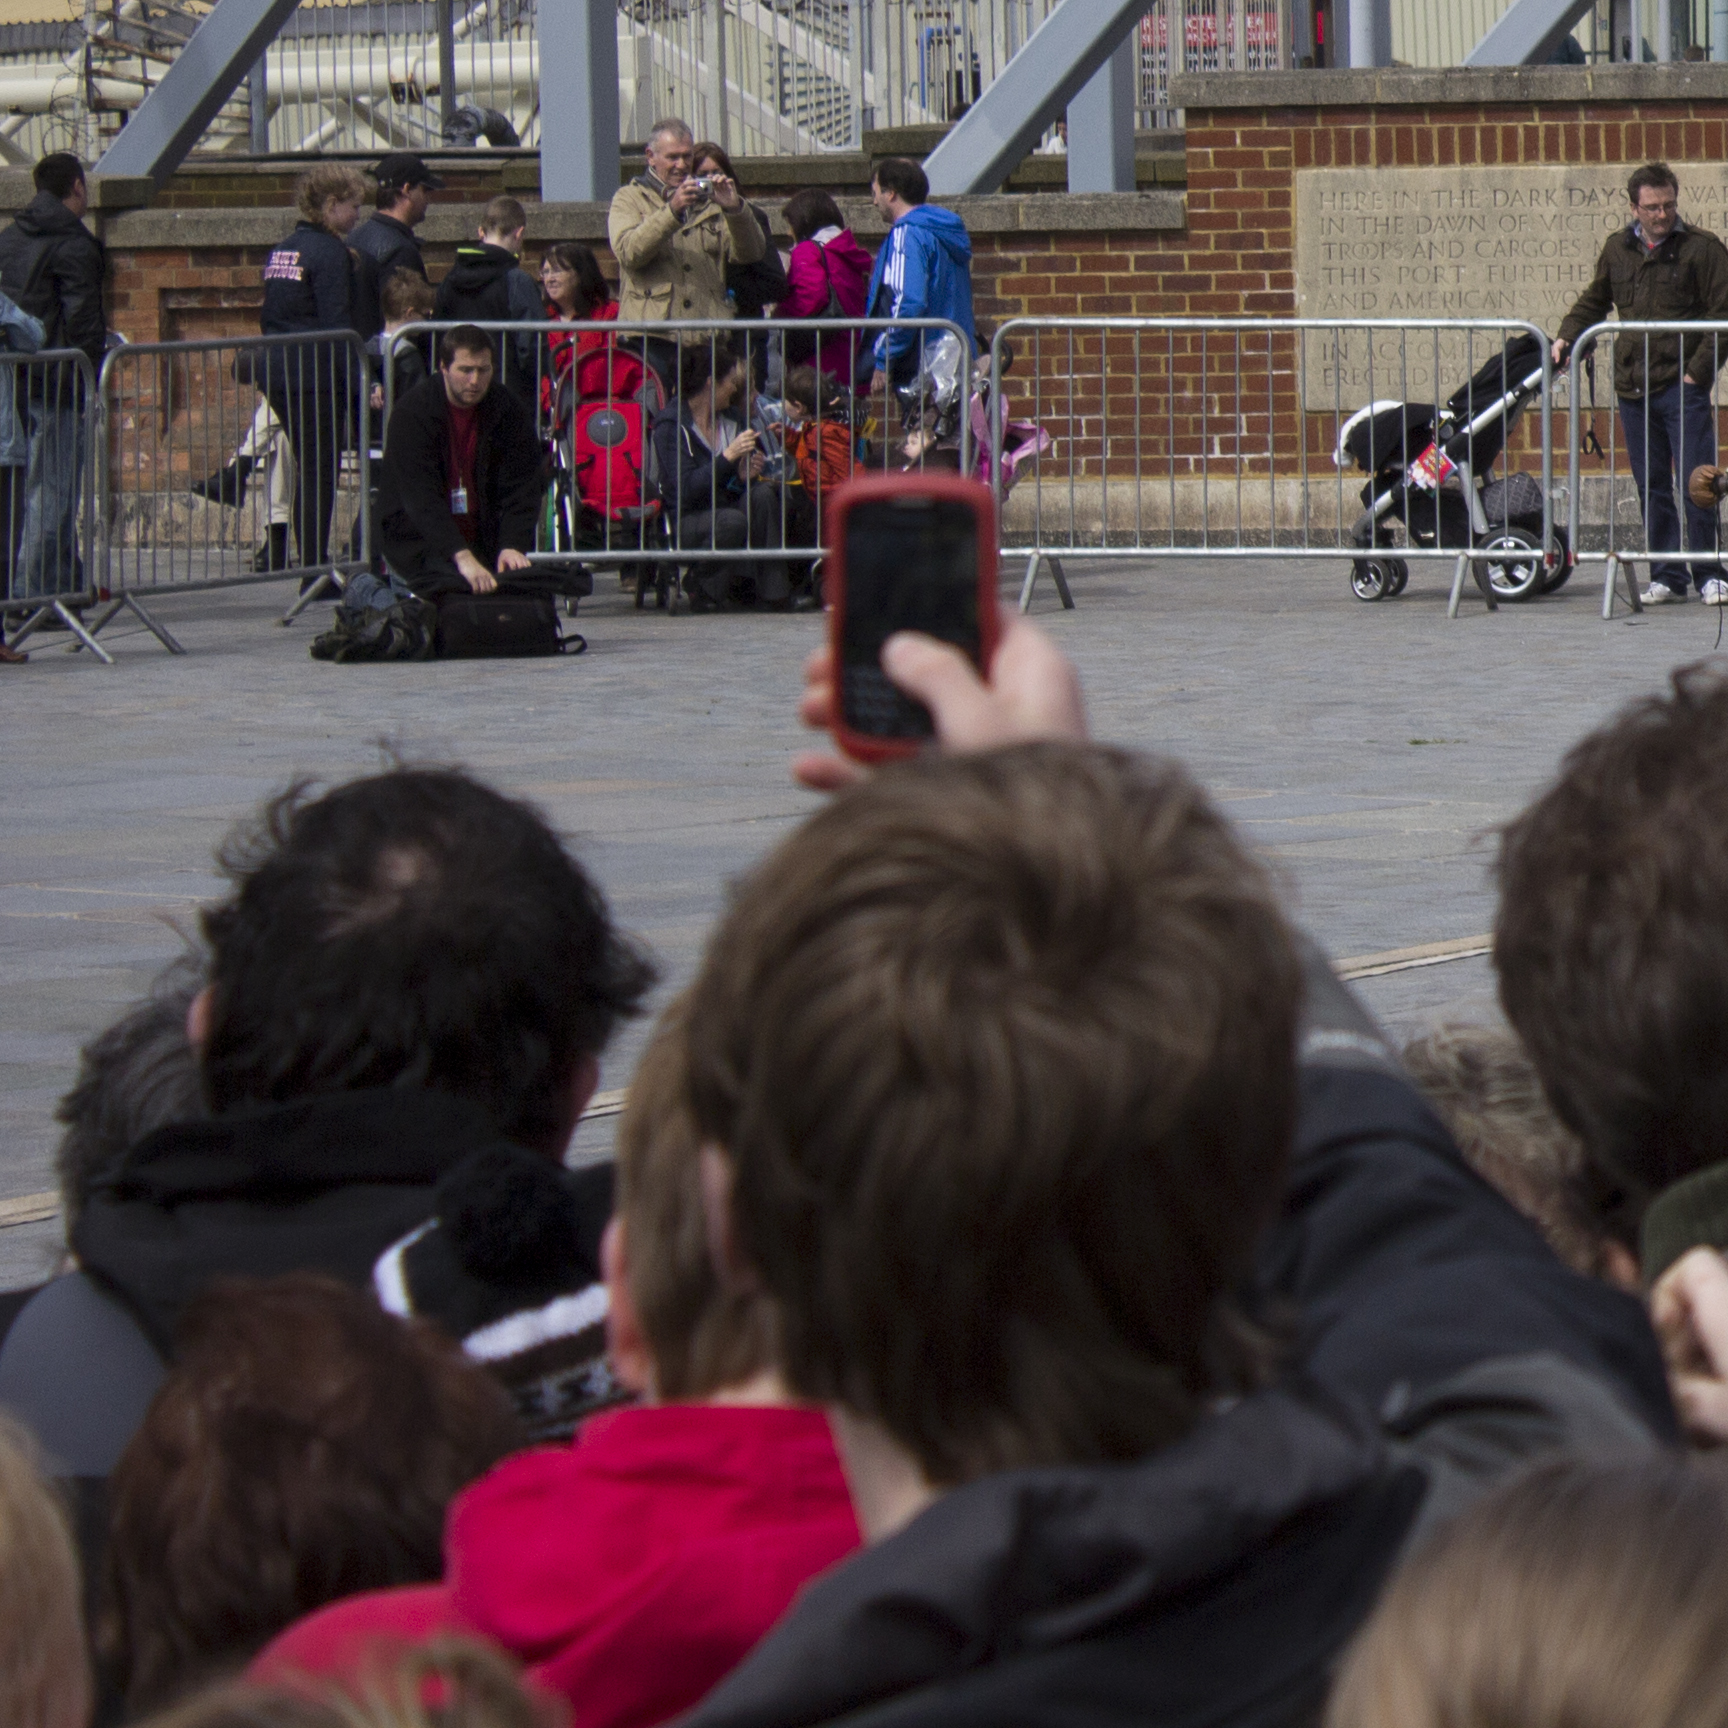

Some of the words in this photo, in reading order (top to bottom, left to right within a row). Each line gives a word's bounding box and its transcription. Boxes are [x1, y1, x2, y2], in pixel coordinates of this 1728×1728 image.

[1318, 189, 1384, 212] HERE
[1393, 189, 1420, 210] IN
[1430, 188, 1482, 209] THE
[1492, 187, 1558, 208] DARK
[1567, 186, 1628, 208] DAYS
[1319, 215, 1346, 235] IN
[1356, 214, 1406, 235] THE
[1415, 213, 1487, 234] DAWN
[1497, 213, 1529, 233] OF
[1540, 212, 1634, 233] VICTOR
[1321, 240, 1404, 261] TROOPS
[1412, 239, 1465, 261] AND
[1474, 238, 1581, 259] CARGOES
[1321, 265, 1381, 287] THIS
[1398, 264, 1467, 285] PORT
[1322, 291, 1379, 312] AND
[1388, 289, 1529, 311] AMERICANS
[1322, 343, 1349, 361] IN
[1439, 367, 1466, 385] BY
